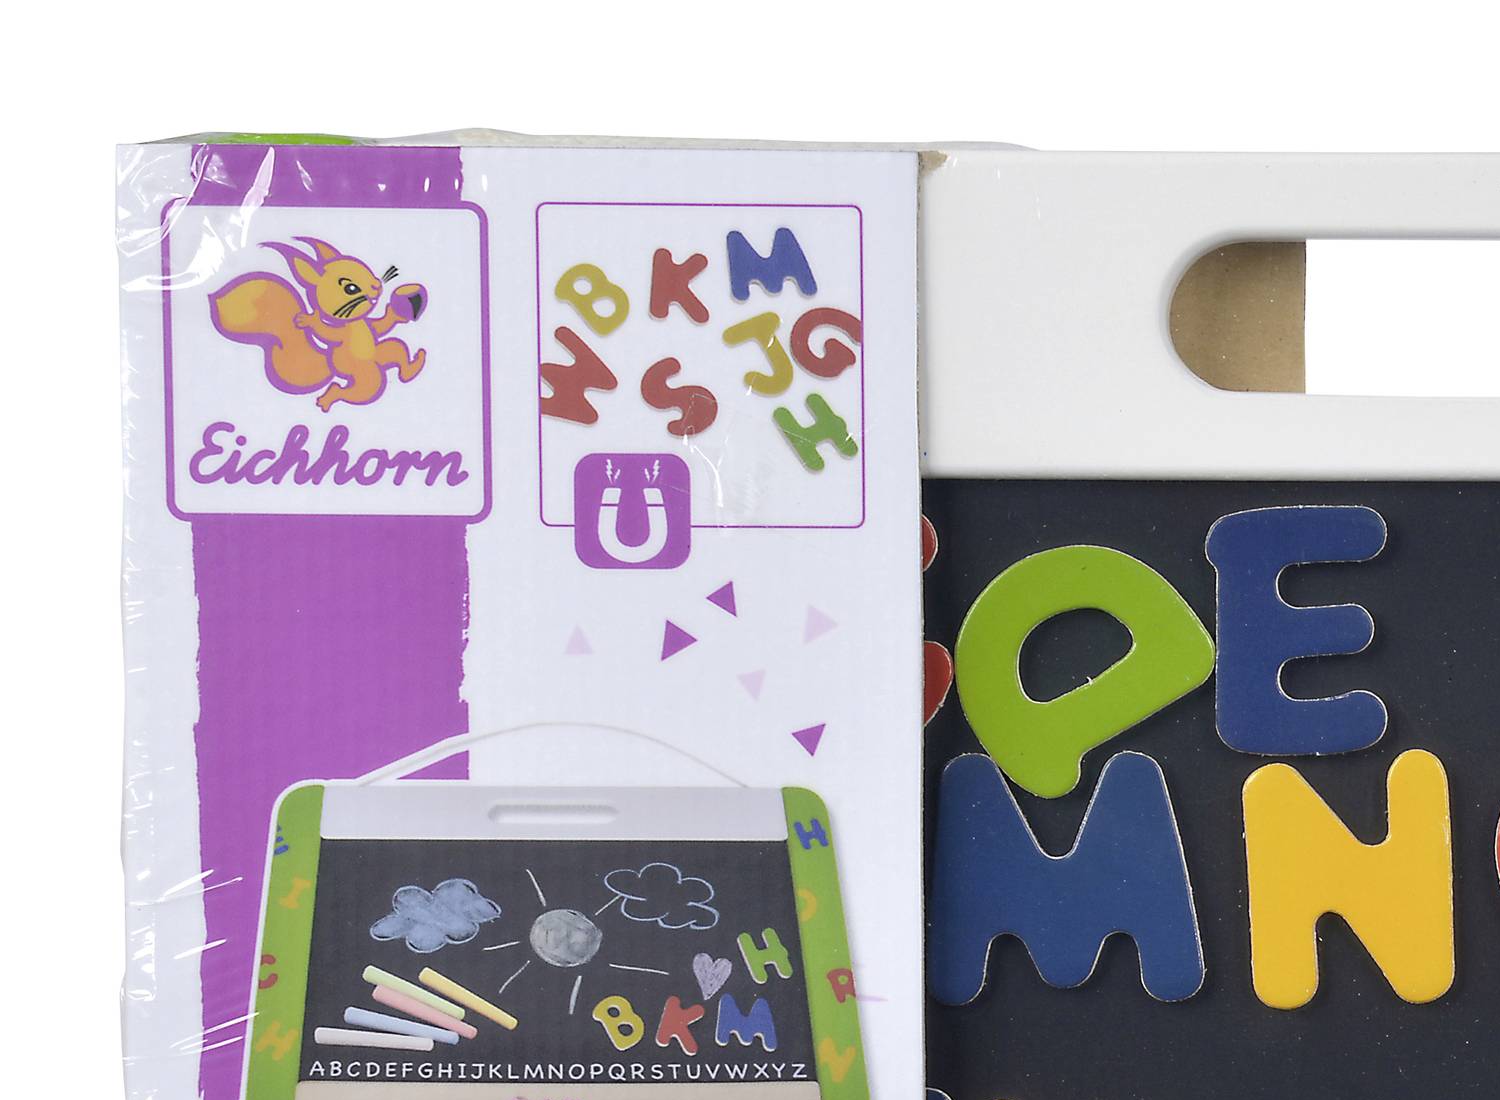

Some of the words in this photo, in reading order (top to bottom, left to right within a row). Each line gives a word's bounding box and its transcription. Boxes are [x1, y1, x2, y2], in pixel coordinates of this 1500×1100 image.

[554, 263, 630, 336] B
[649, 247, 709, 324] K
[726, 227, 818, 301] M
[722, 312, 794, 395] J
[640, 357, 718, 437] S
[773, 393, 858, 470] H
[188, 421, 469, 487] Eichhorn
[1205, 505, 1388, 756] E
[794, 818, 829, 850] H
[925, 750, 1205, 1005] M
[1242, 748, 1456, 1009] N
[736, 927, 793, 983] H
[592, 996, 644, 1050] B
[656, 996, 704, 1055] K
[715, 993, 778, 1051] M
